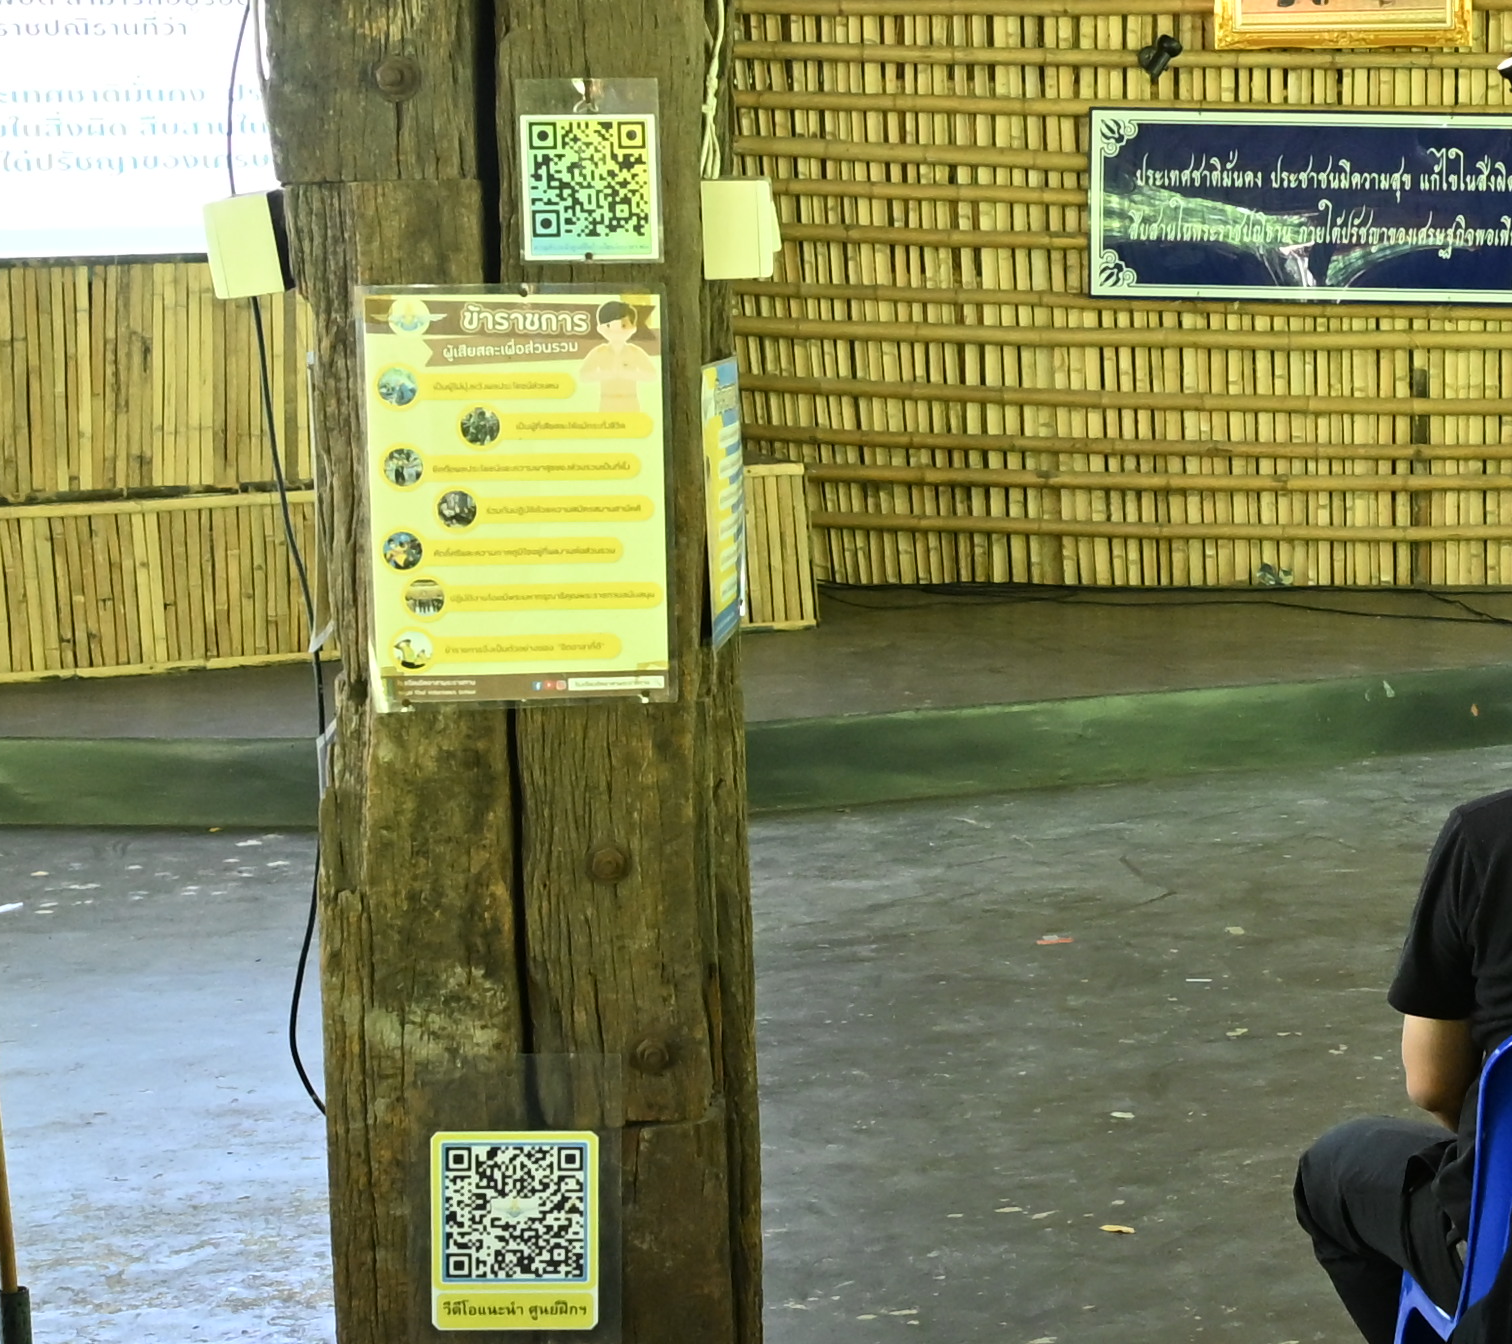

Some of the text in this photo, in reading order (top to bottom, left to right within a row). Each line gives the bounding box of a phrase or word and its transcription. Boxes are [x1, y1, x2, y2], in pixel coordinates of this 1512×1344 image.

[1135, 148, 1262, 188] ประเทศชาติมั่นคง
[1270, 154, 1412, 205] ประชาชนมีความสุข
[461, 304, 590, 335] ข้าราชการ
[442, 338, 579, 362] ผู้เสียสละเพื่อส่วนรวม
